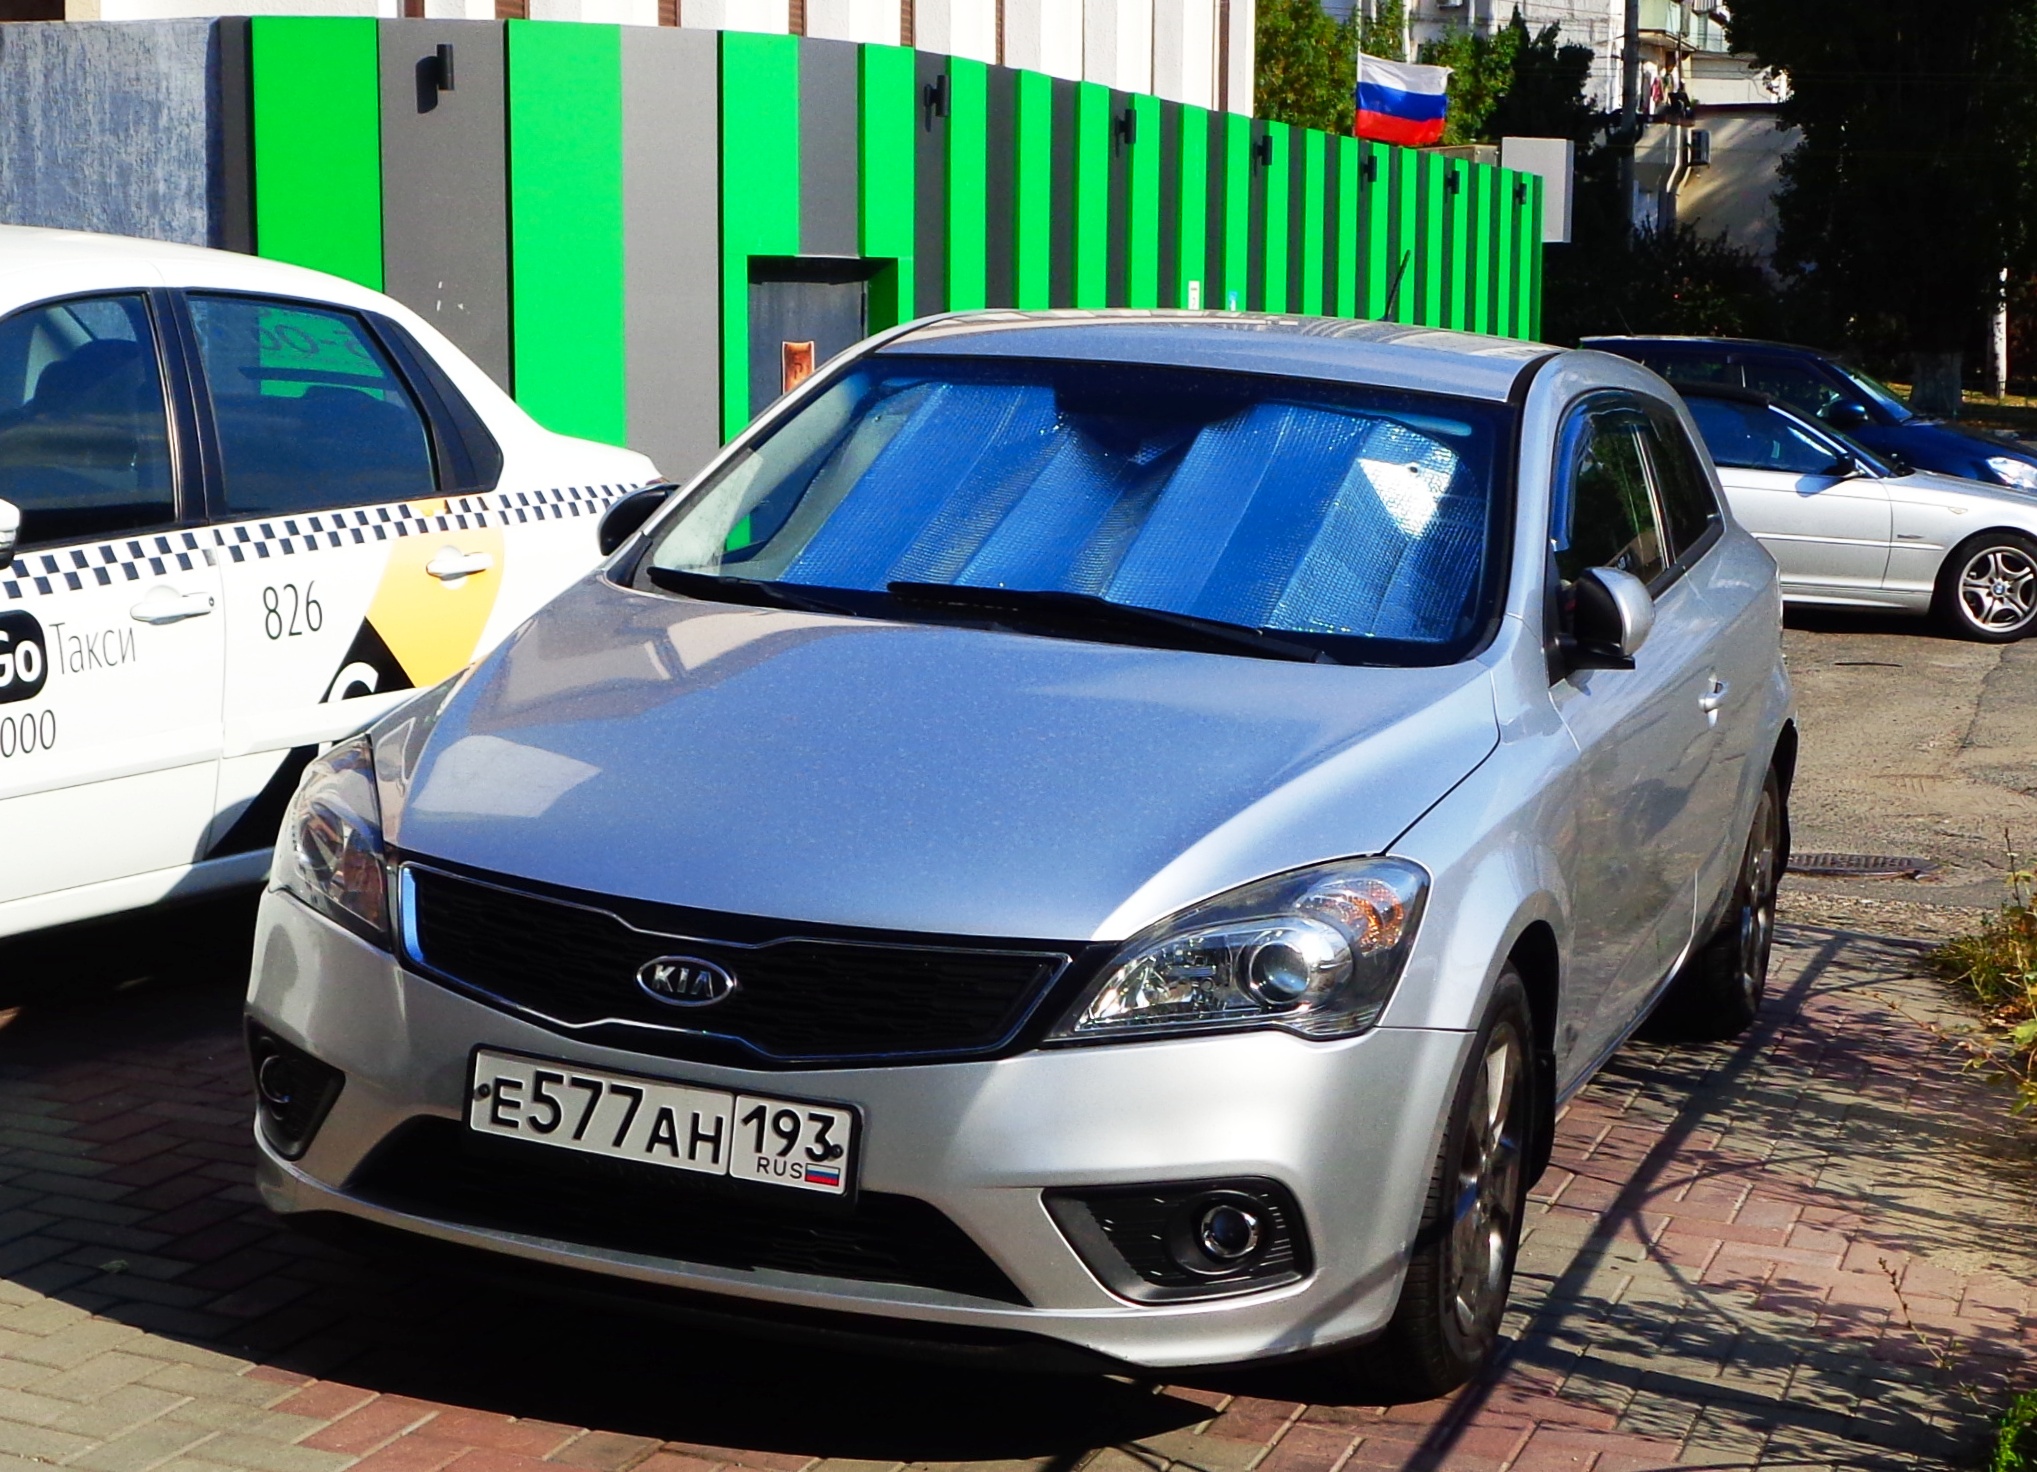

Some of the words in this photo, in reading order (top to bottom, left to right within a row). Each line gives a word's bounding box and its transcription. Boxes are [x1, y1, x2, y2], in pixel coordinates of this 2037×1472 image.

[262, 579, 323, 640] 826
[48, 622, 136, 675] Такси
[0, 709, 56, 758] 000
[651, 964, 714, 998] KIA
[741, 1104, 836, 1162] 193
[756, 1156, 803, 1180] RUS
